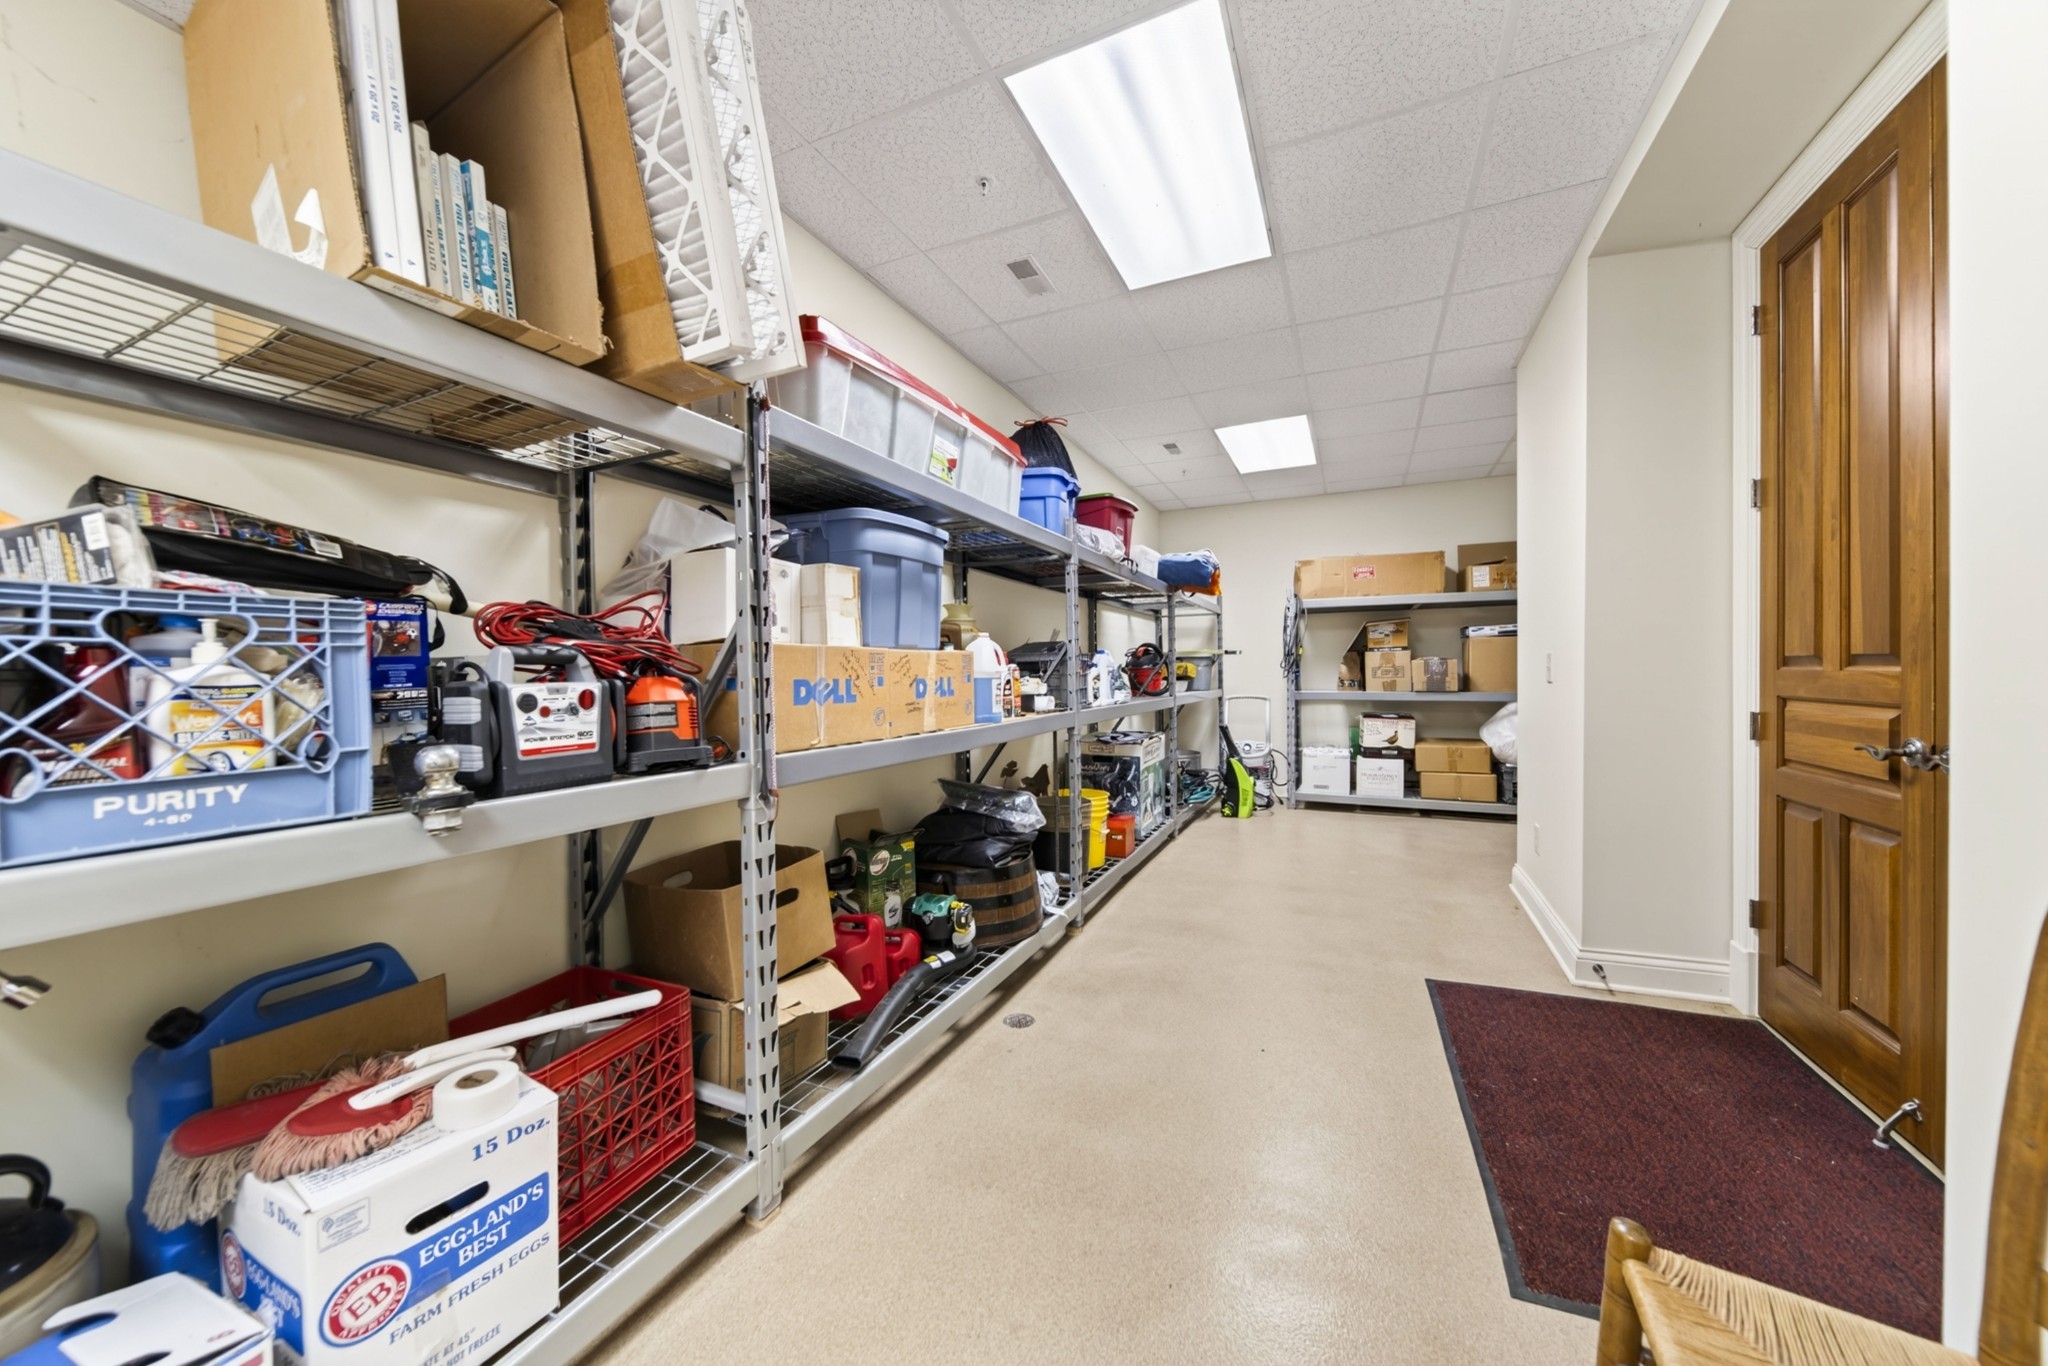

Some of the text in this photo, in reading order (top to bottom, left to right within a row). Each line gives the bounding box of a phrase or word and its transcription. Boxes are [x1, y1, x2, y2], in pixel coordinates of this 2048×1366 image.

[368, 90, 378, 102] 20
[391, 100, 400, 113] 20
[370, 110, 380, 123] 20
[393, 120, 402, 133] 20
[915, 675, 955, 700] DLL
[93, 784, 248, 820] PURITY
[472, 1135, 499, 1162] 15
[507, 1117, 551, 1145] Doz.
[418, 1182, 545, 1268] EGG-LAND'S
[458, 1220, 512, 1268] BEST
[329, 1264, 393, 1318] QUALITY
[343, 1281, 392, 1321] EB
[388, 1231, 551, 1345] FARM FRESH EGGS
[338, 1280, 406, 1339] APPROVED
[468, 1323, 502, 1356] FREEZE
